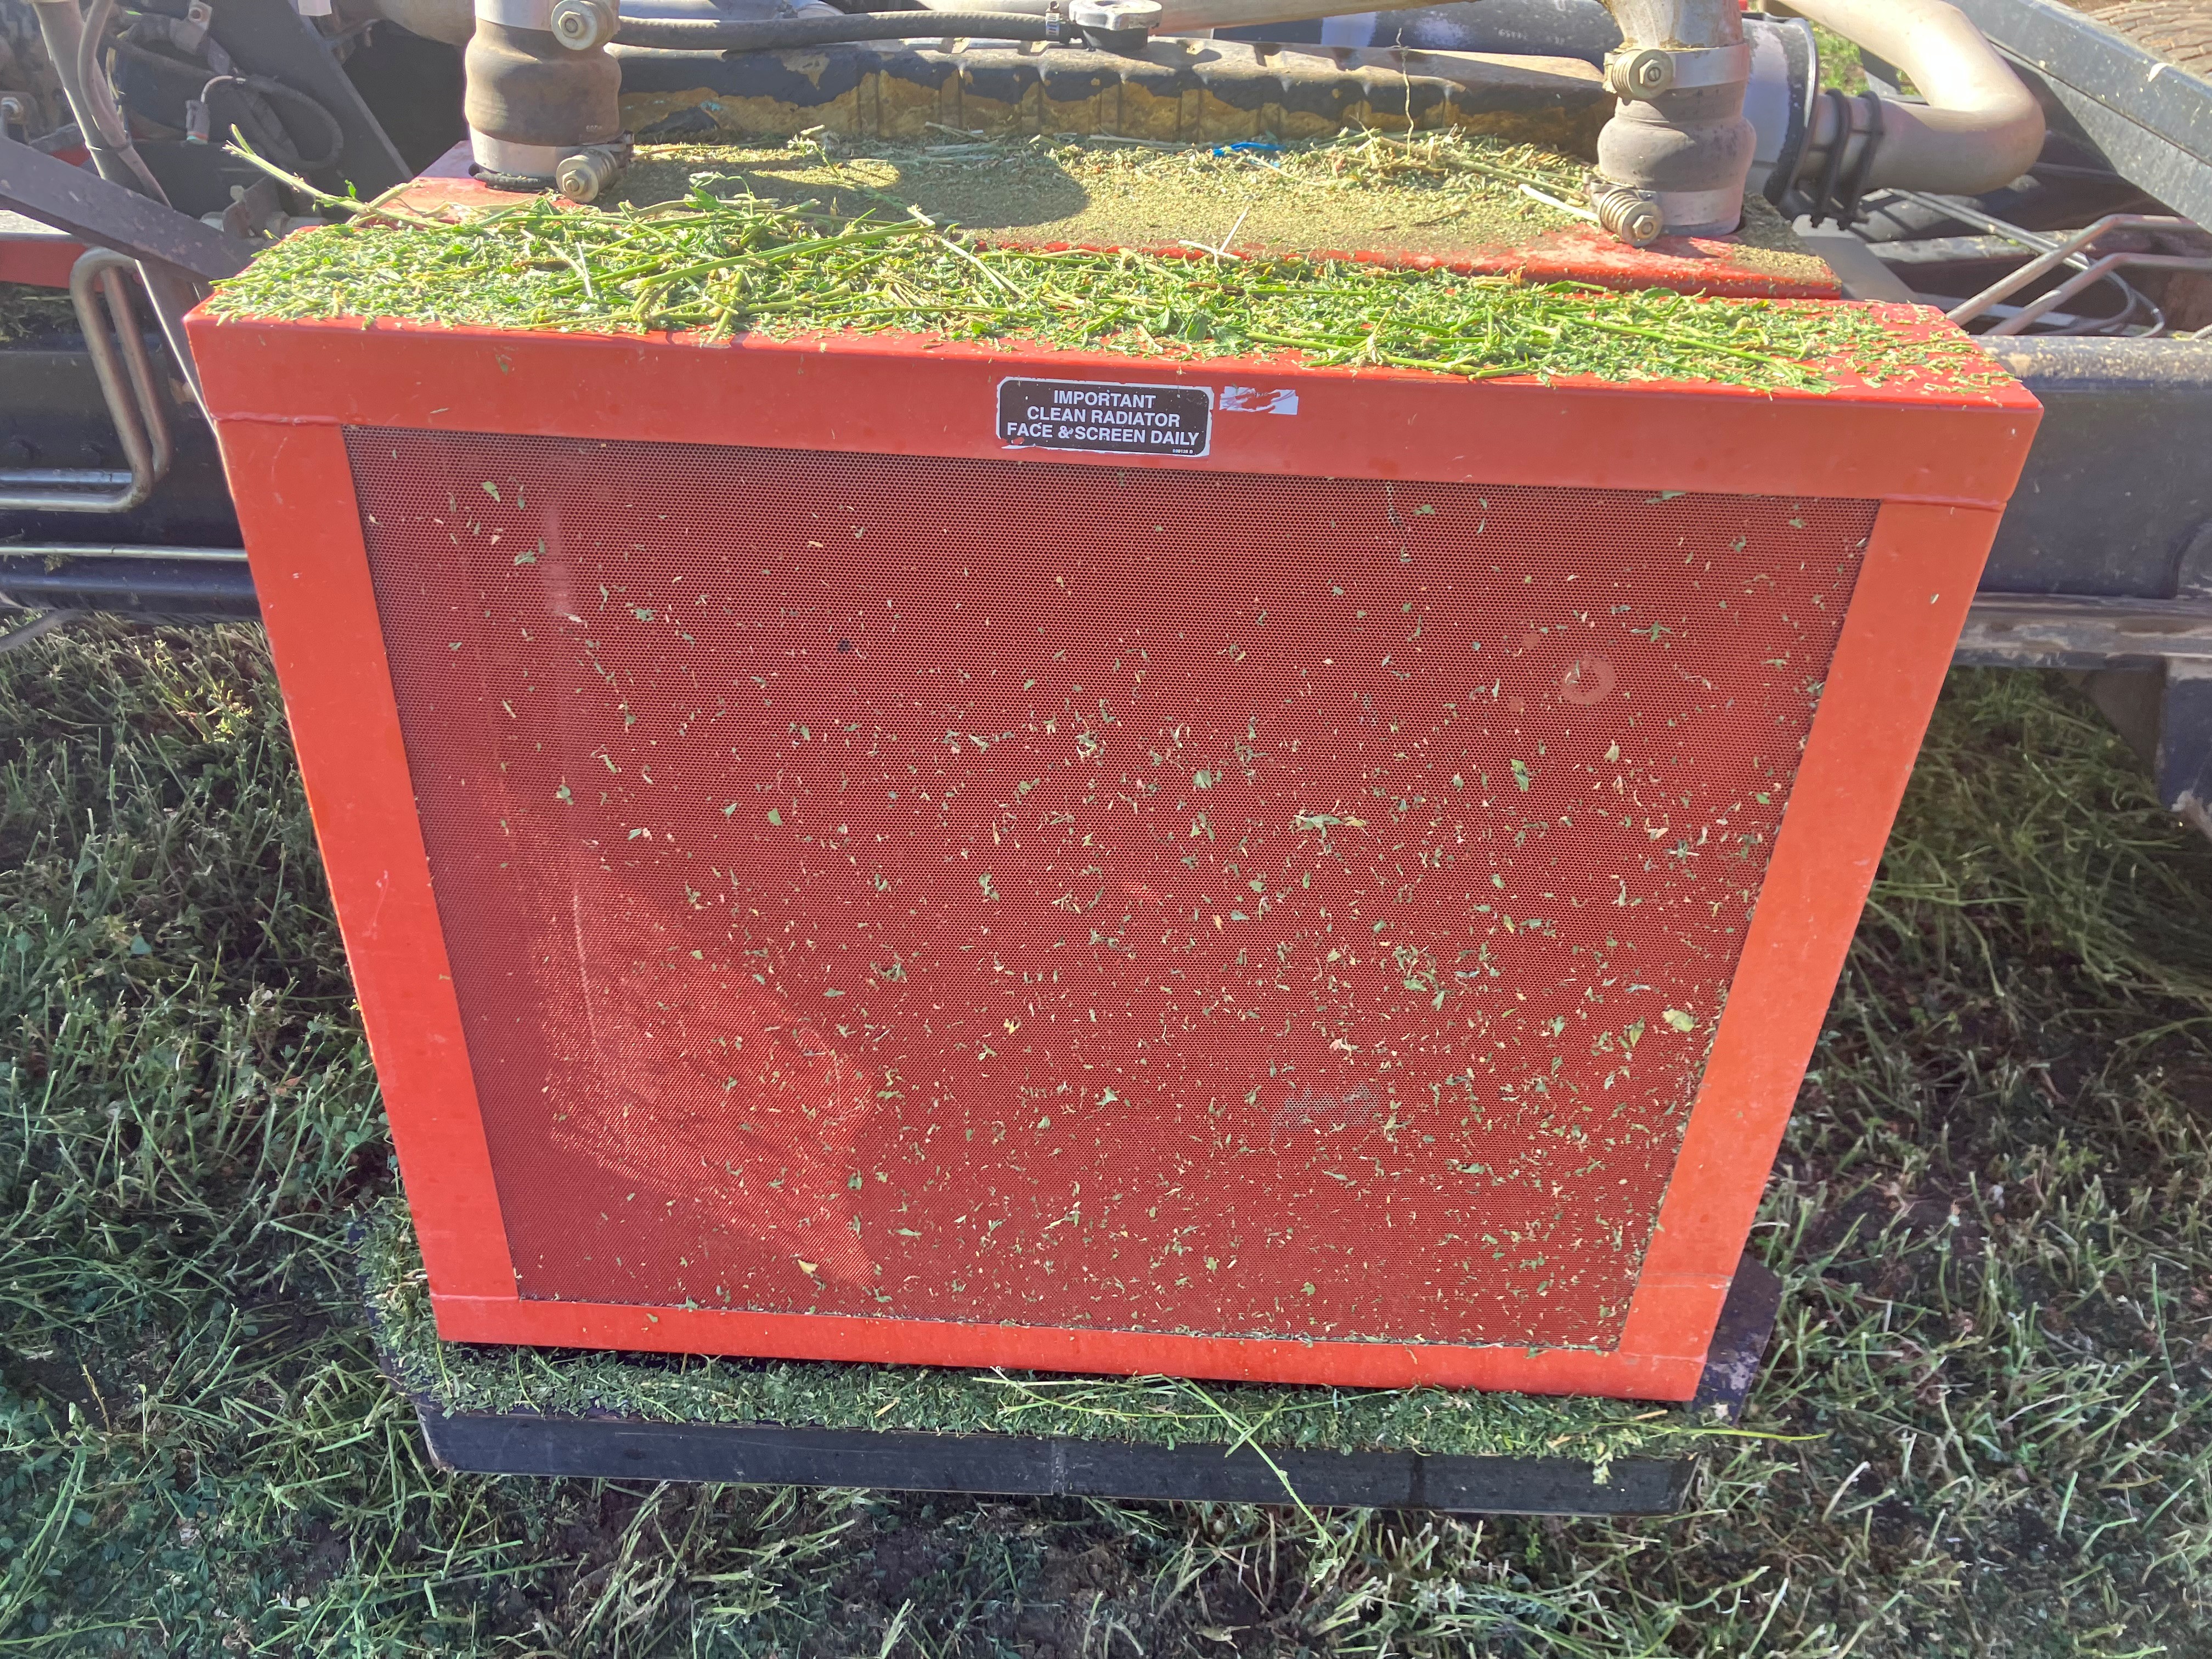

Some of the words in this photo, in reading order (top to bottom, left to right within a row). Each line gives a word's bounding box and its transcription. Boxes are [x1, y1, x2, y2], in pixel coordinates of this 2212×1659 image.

[1054, 390, 1156, 409] IMPORTANT
[1027, 405, 1086, 422] CLEAN
[1091, 409, 1181, 428] RADIATOR
[1007, 422, 1053, 438] FACE
[1058, 425, 1070, 439] &
[1074, 426, 1146, 443] SCREEN
[1150, 430, 1200, 445] DAILY
